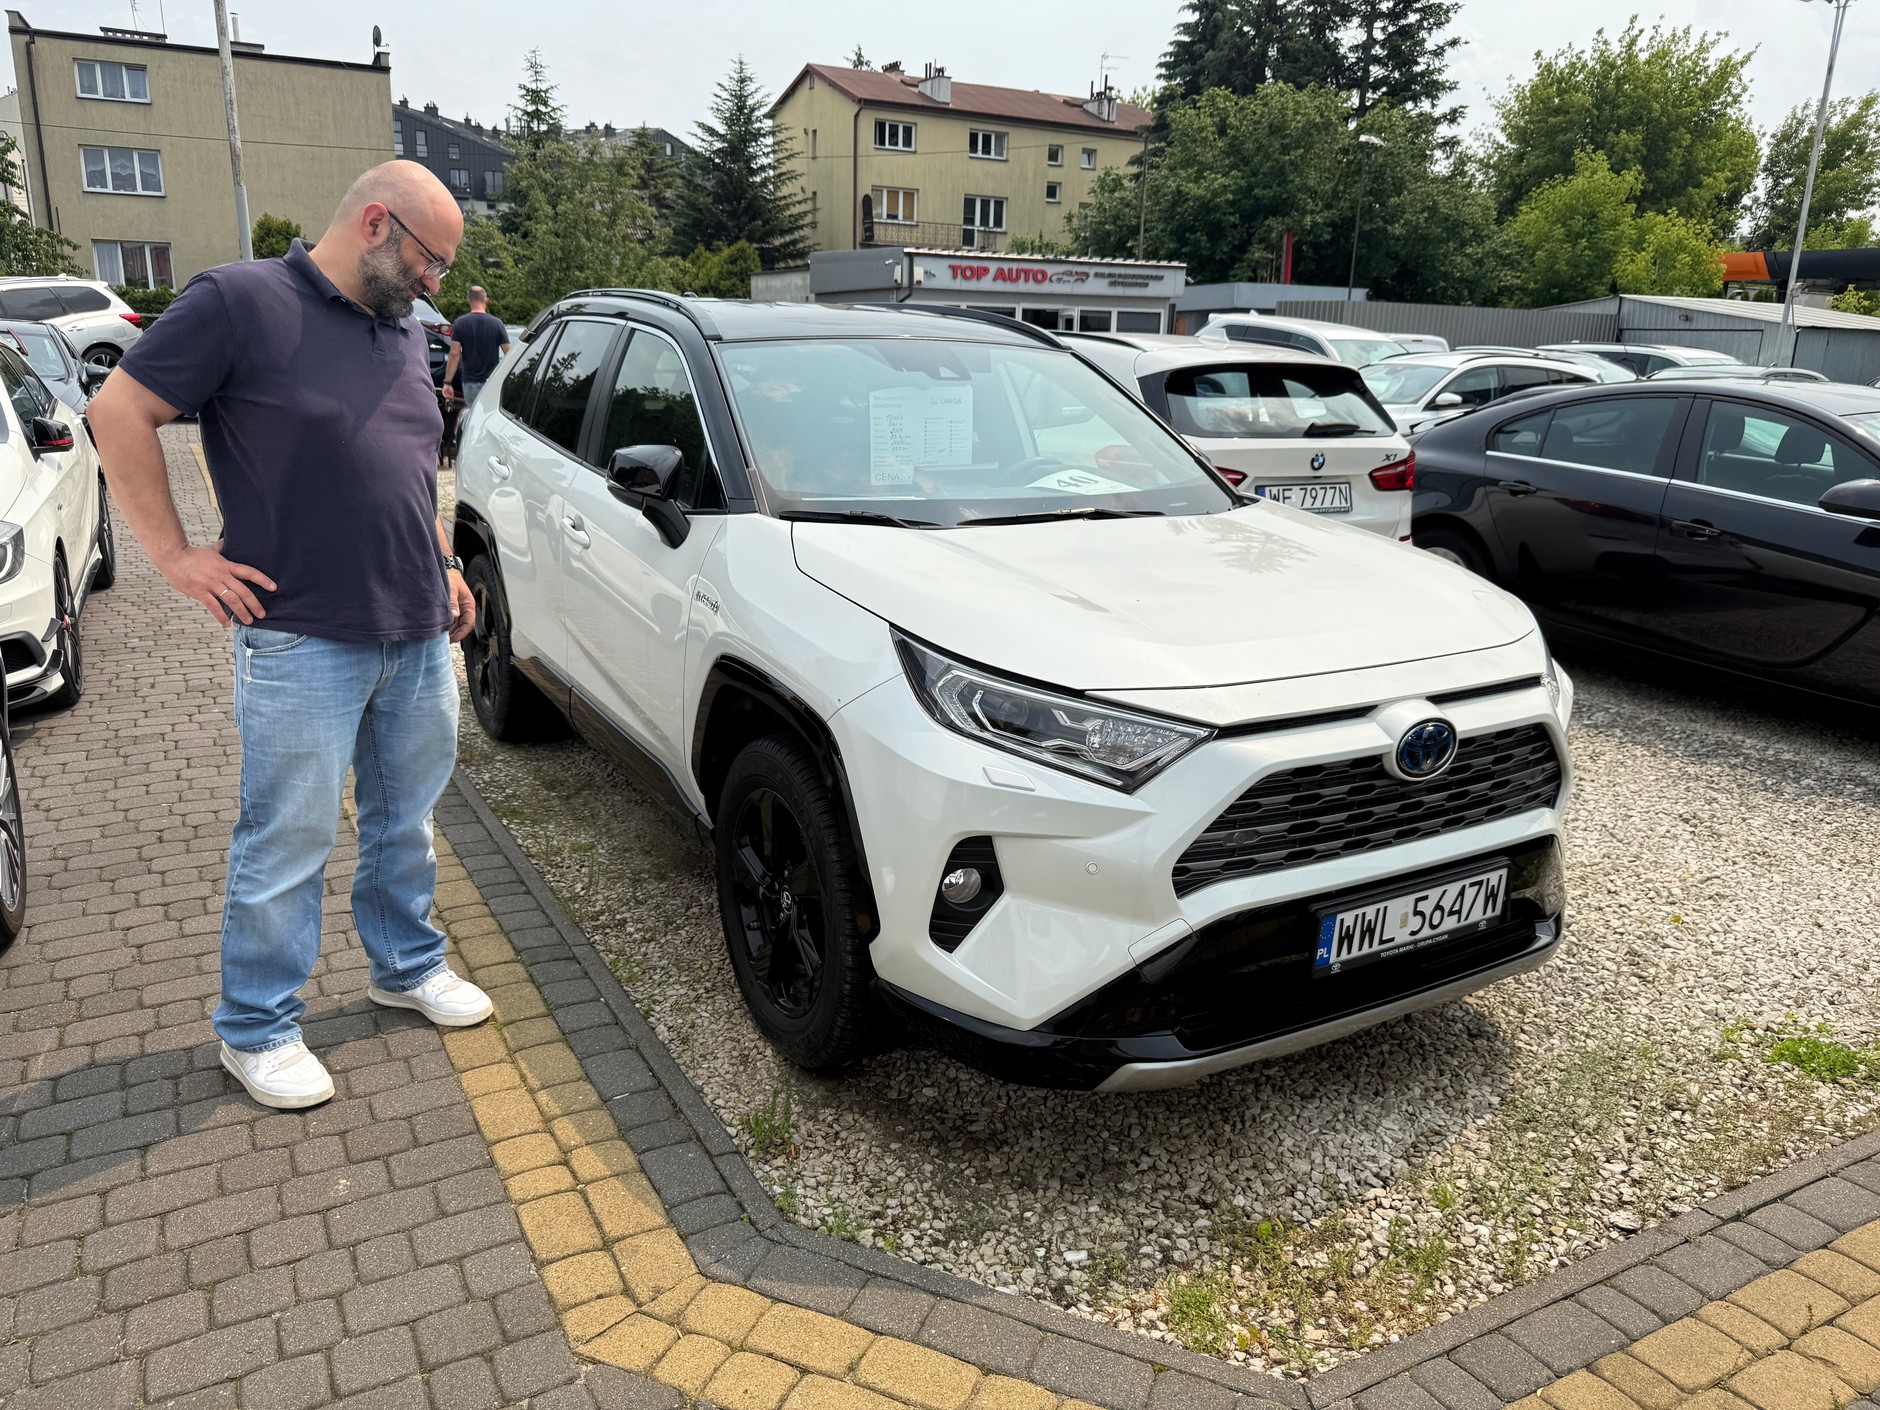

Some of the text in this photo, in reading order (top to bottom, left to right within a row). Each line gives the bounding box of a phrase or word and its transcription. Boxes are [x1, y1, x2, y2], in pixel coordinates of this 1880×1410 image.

[949, 264, 1048, 284] TOP AUTO
[1382, 453, 1398, 462] X1
[1056, 475, 1099, 488] 40
[1299, 485, 1349, 508] 7977N
[1335, 874, 1503, 958] WWL 5647W
[1316, 948, 1330, 961] PL
